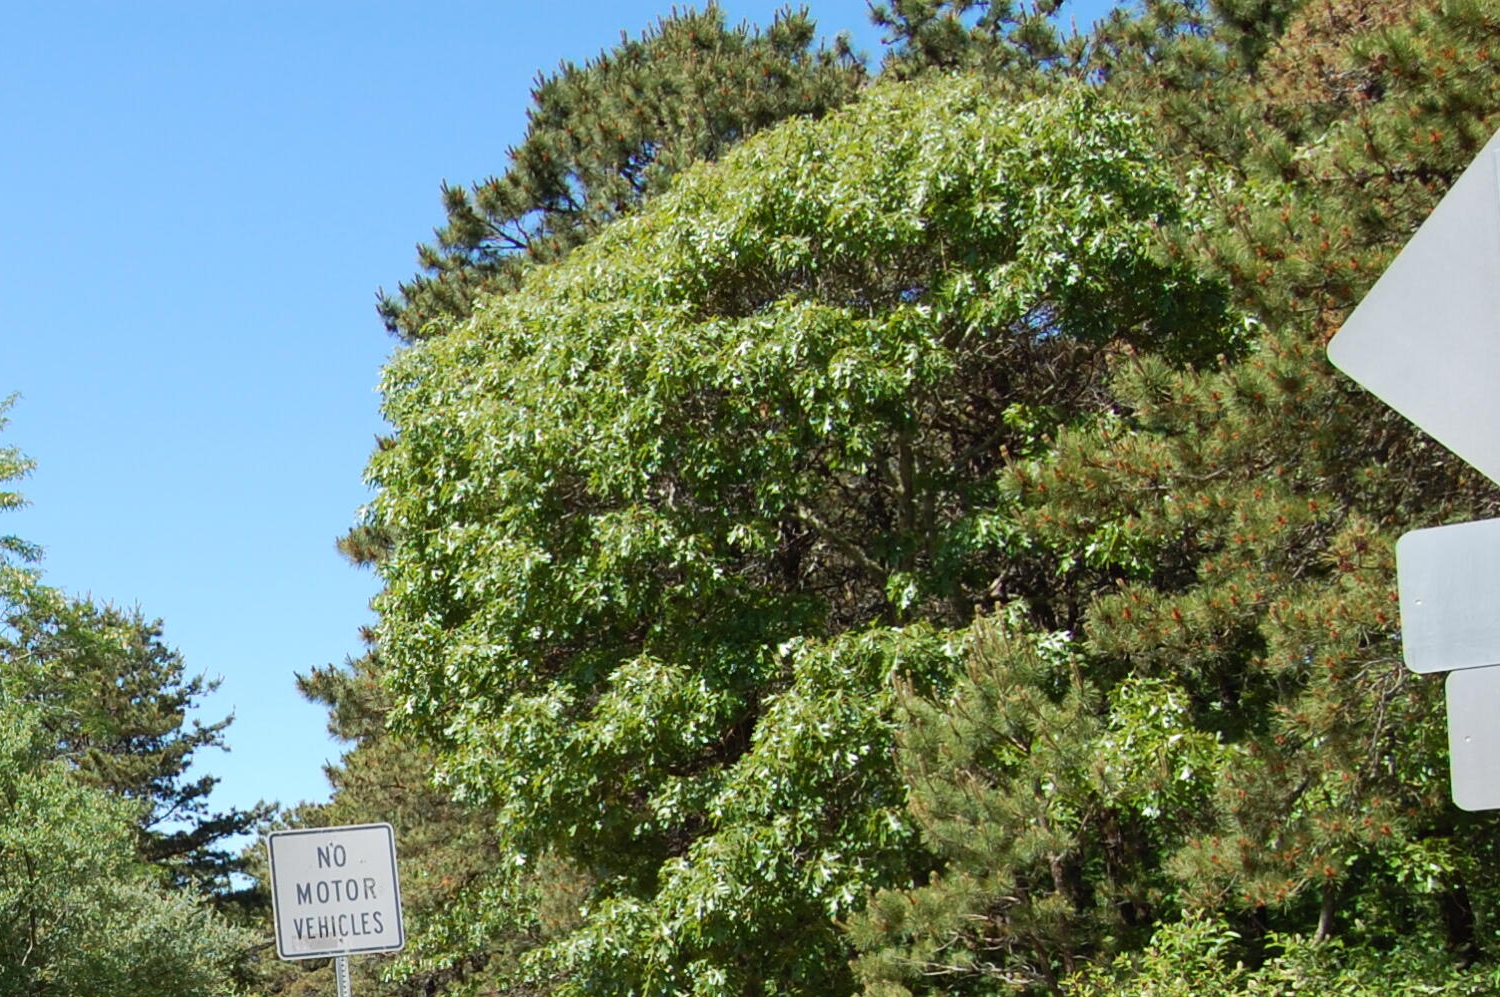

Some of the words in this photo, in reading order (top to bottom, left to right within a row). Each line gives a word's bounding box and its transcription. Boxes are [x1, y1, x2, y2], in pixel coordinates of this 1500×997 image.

[317, 844, 346, 869] NO
[296, 877, 377, 905] MOTOR
[293, 911, 384, 940] VEHICLES
